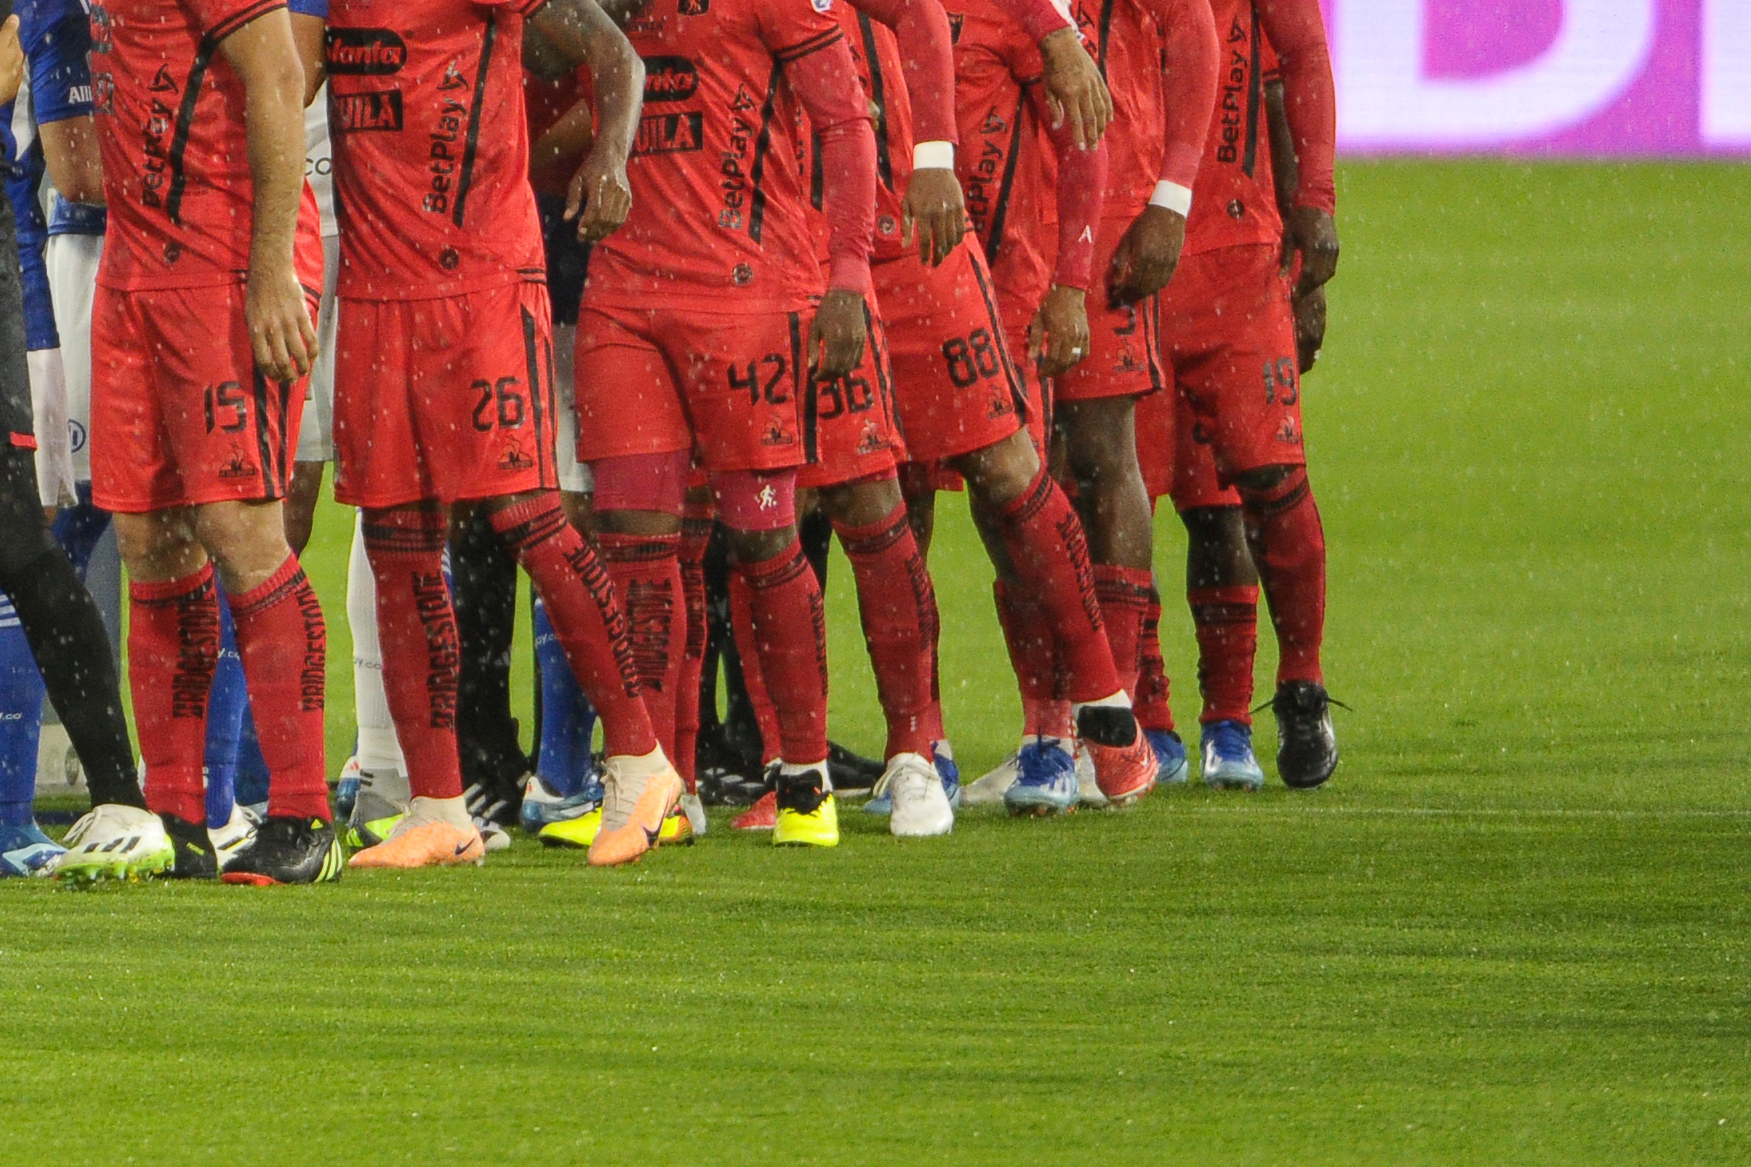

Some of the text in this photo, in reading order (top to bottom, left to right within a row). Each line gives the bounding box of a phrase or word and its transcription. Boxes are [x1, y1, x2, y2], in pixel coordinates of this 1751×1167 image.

[1217, 49, 1248, 164] BetPlay
[422, 96, 468, 214] BetPlay
[718, 116, 755, 229] BetPlay
[727, 353, 788, 407] 42
[941, 328, 999, 388] 88
[1262, 356, 1298, 406] 19
[204, 380, 247, 435] 15
[471, 376, 526, 431] 26
